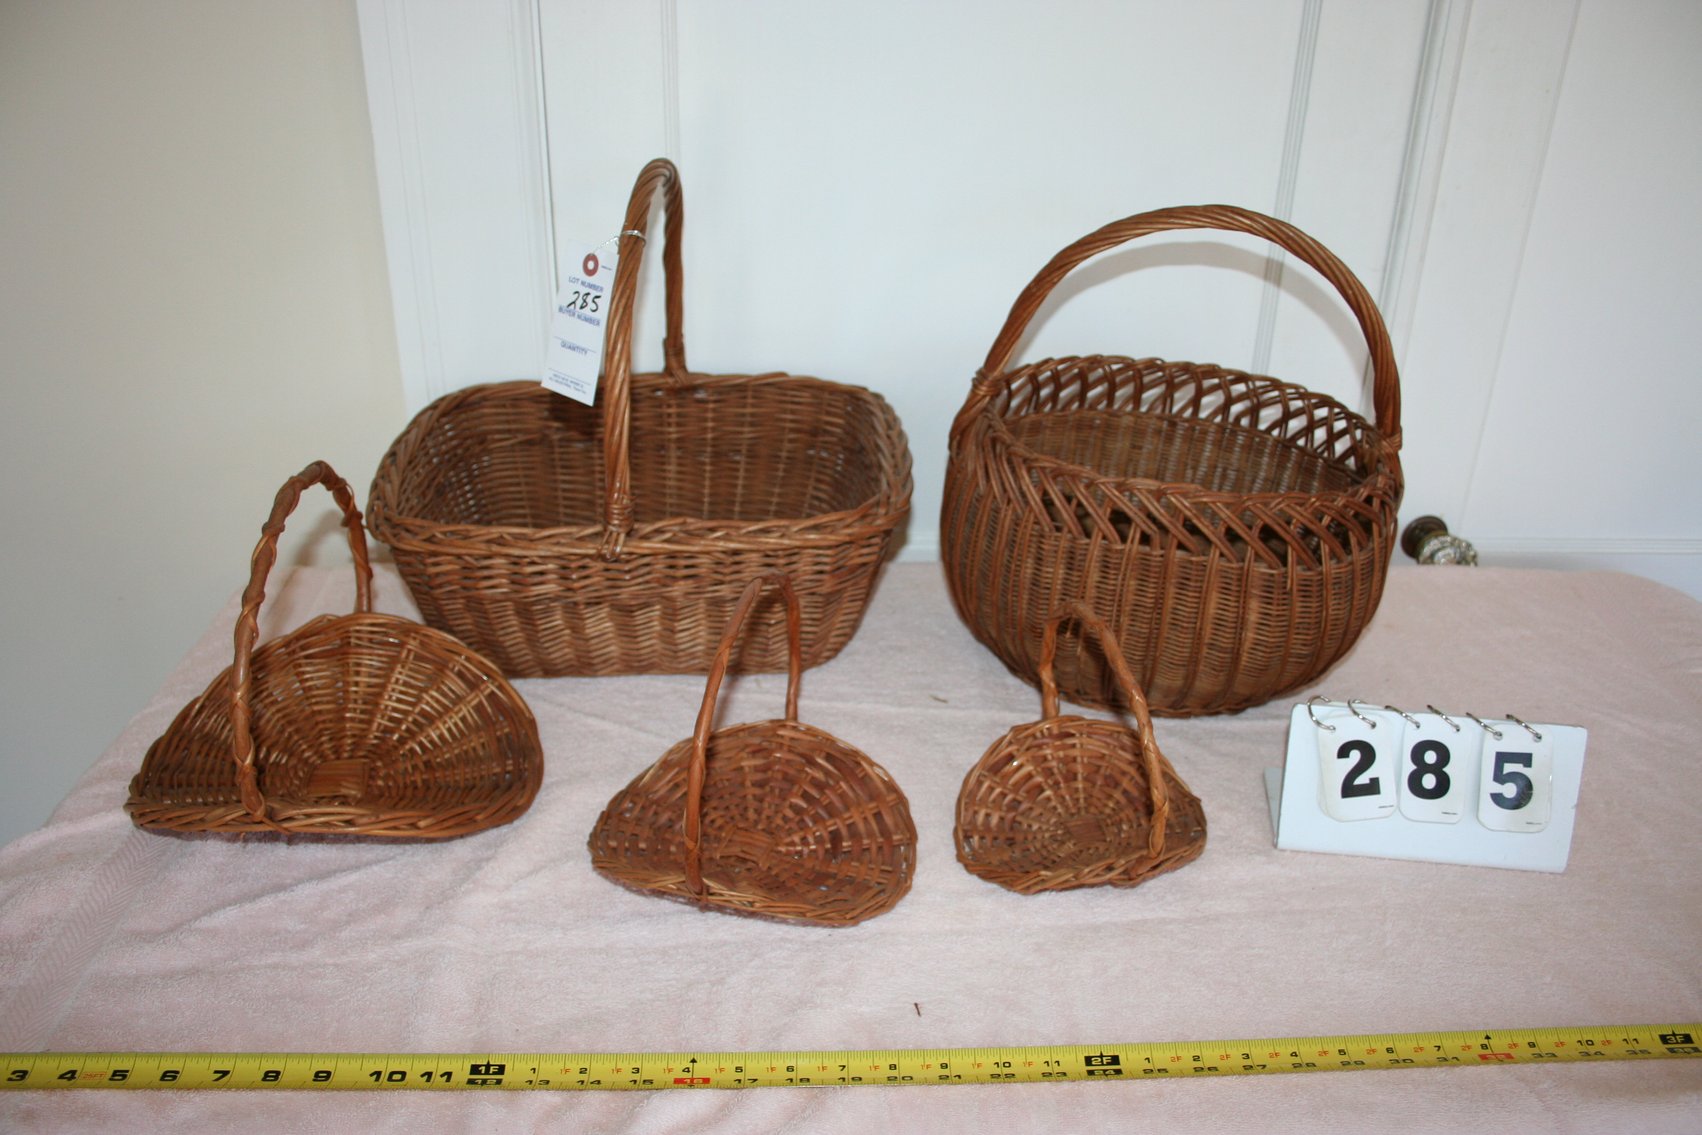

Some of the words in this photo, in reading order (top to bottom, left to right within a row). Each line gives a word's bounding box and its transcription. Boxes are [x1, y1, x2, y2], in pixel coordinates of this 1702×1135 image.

[568, 276, 579, 285] LOT
[580, 280, 604, 293] NUMBER
[566, 290, 602, 313] 285
[558, 305, 576, 319] BUYER
[576, 313, 601, 327] NUMBER
[560, 340, 588, 356] QUANTITY
[6, 1070, 29, 1082] 3
[57, 1070, 79, 1082] 4
[108, 1070, 130, 1082] 5
[159, 1070, 180, 1082] 6
[212, 1070, 231, 1082] 7
[261, 1070, 282, 1082] 8
[312, 1070, 332, 1082] 9
[368, 1070, 407, 1082] 10
[420, 1071, 453, 1083] 11
[478, 1065, 500, 1075] 1F
[940, 1062, 949, 1070] 9
[993, 1061, 1012, 1069] 10
[1091, 1056, 1112, 1065] 2F
[1666, 1035, 1686, 1044] 3F
